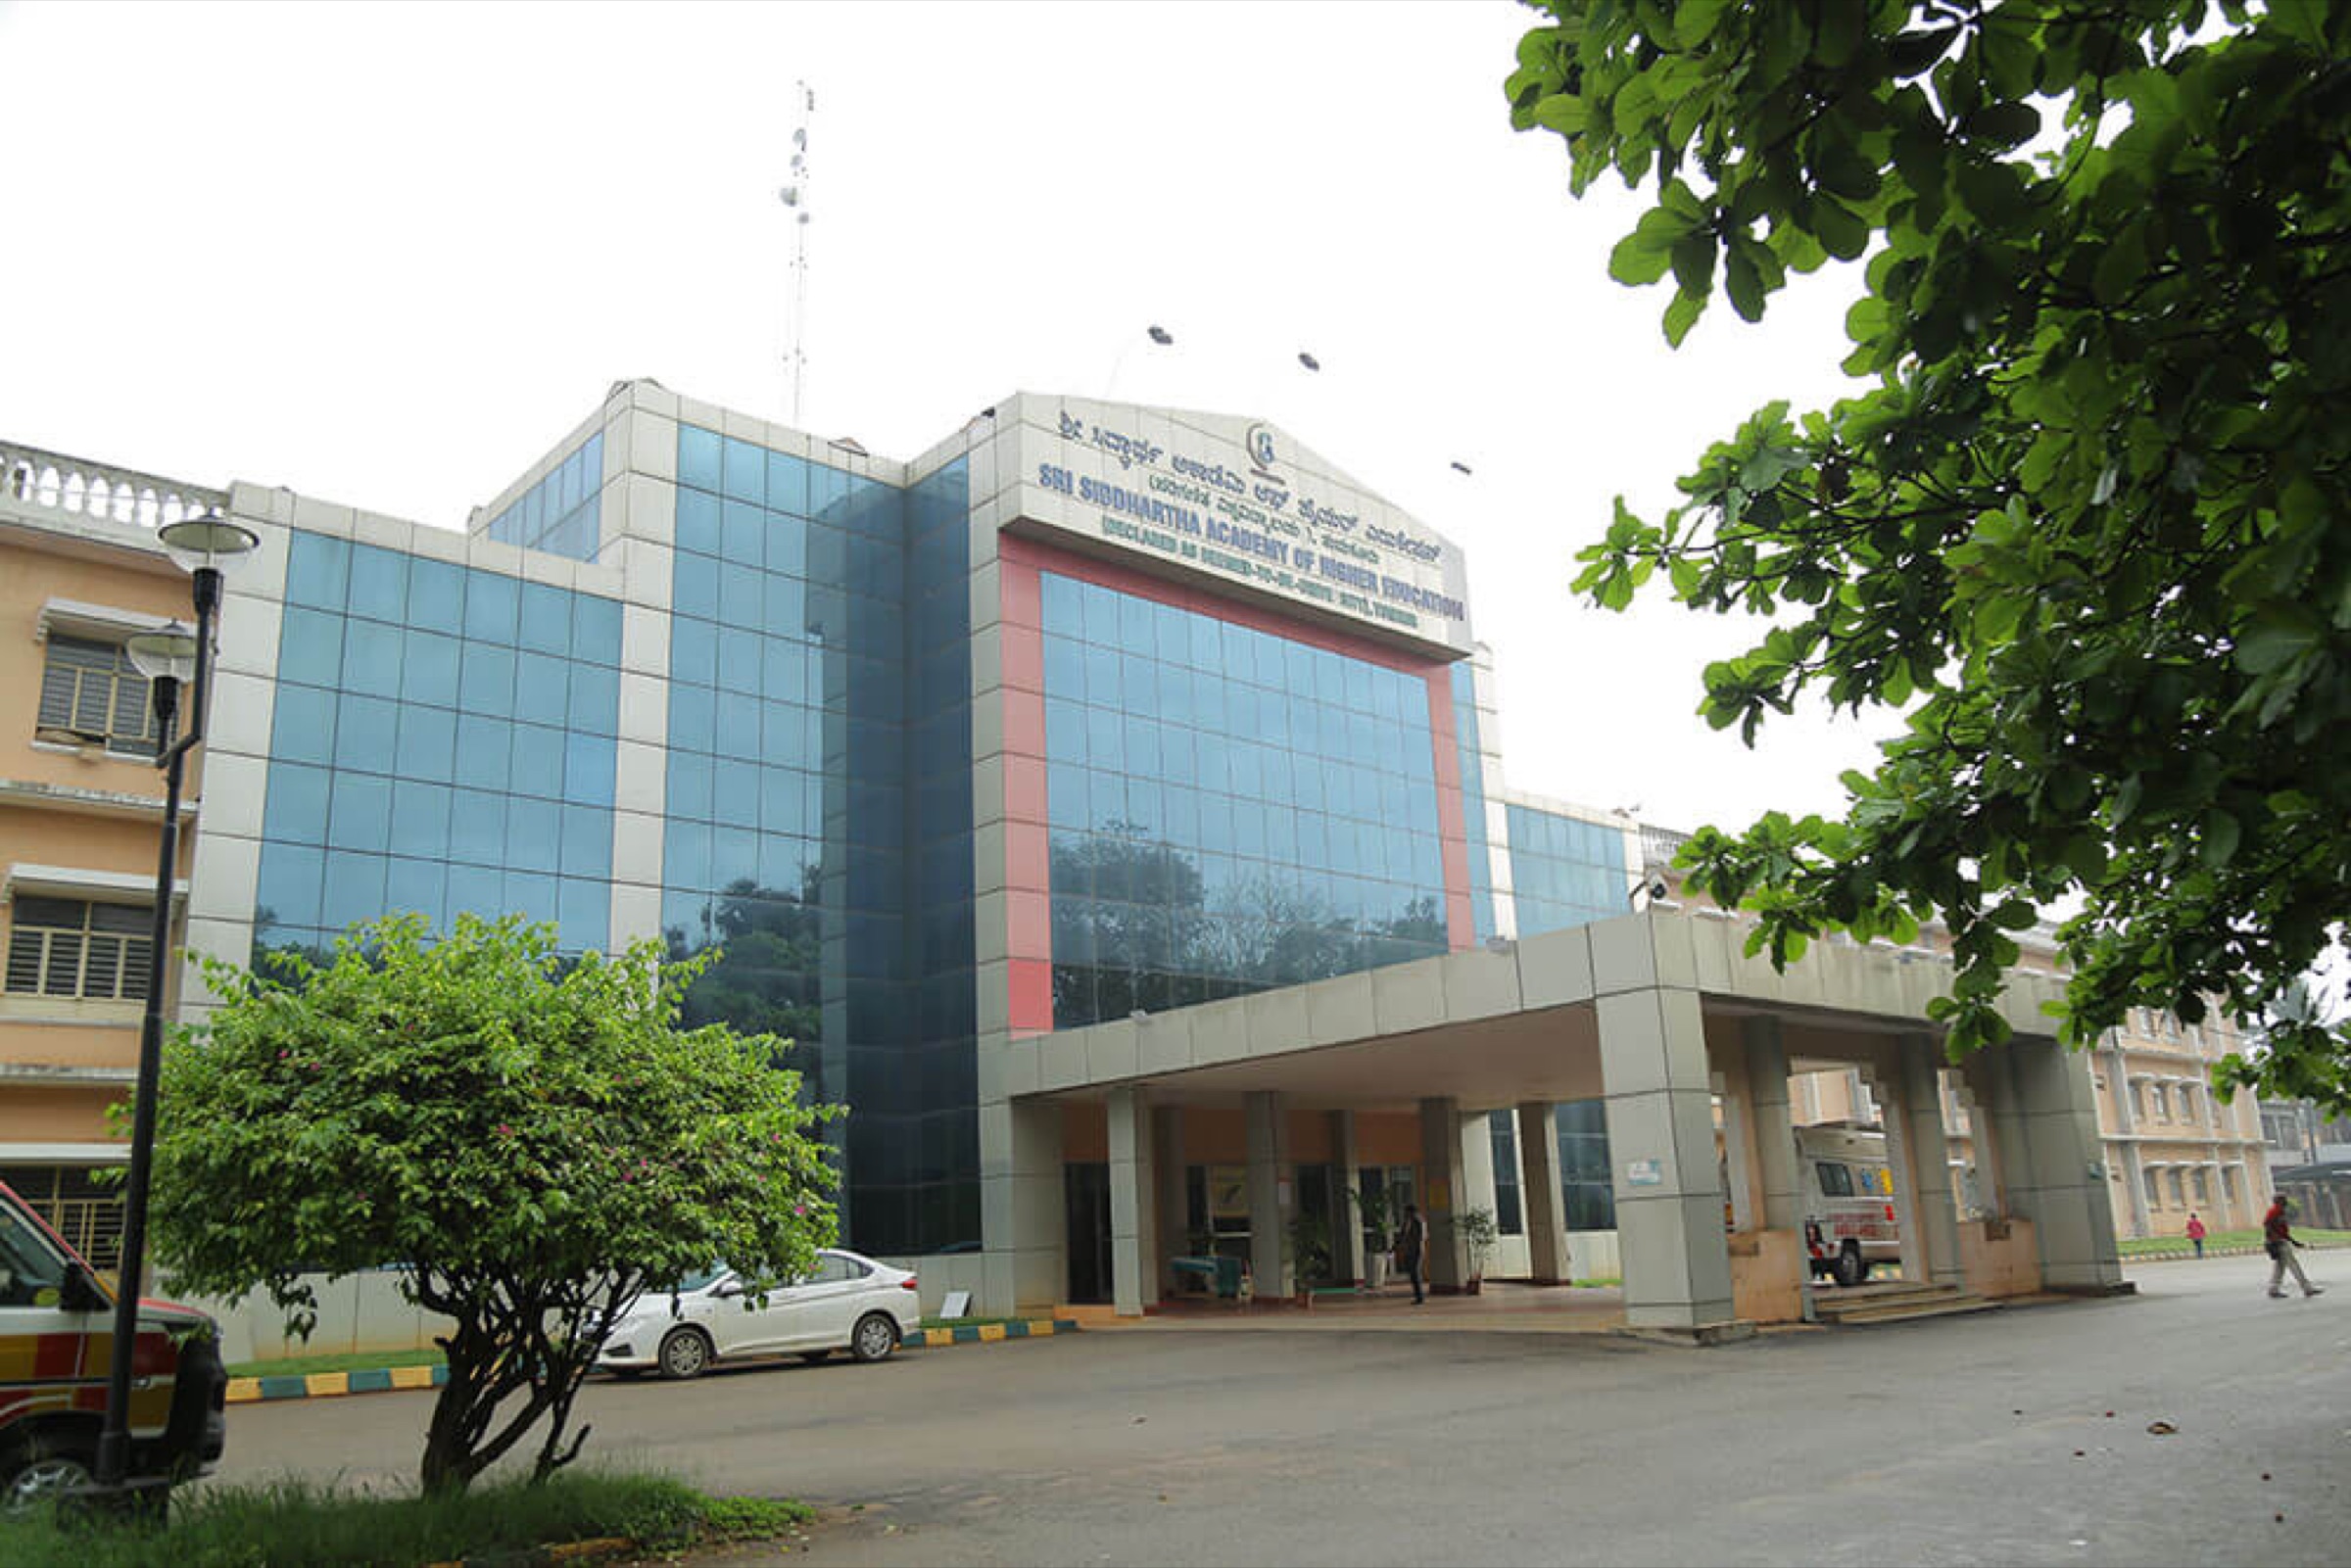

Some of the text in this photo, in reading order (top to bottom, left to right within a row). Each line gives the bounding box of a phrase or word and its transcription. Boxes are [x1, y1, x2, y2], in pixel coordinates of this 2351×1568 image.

[1038, 462, 1074, 495] SRI
[1079, 474, 1202, 536] SIDDHARTHA
[1206, 517, 1289, 566] ACADEMY
[1294, 546, 1315, 571] OF
[1381, 575, 1464, 622] EDUCATION
